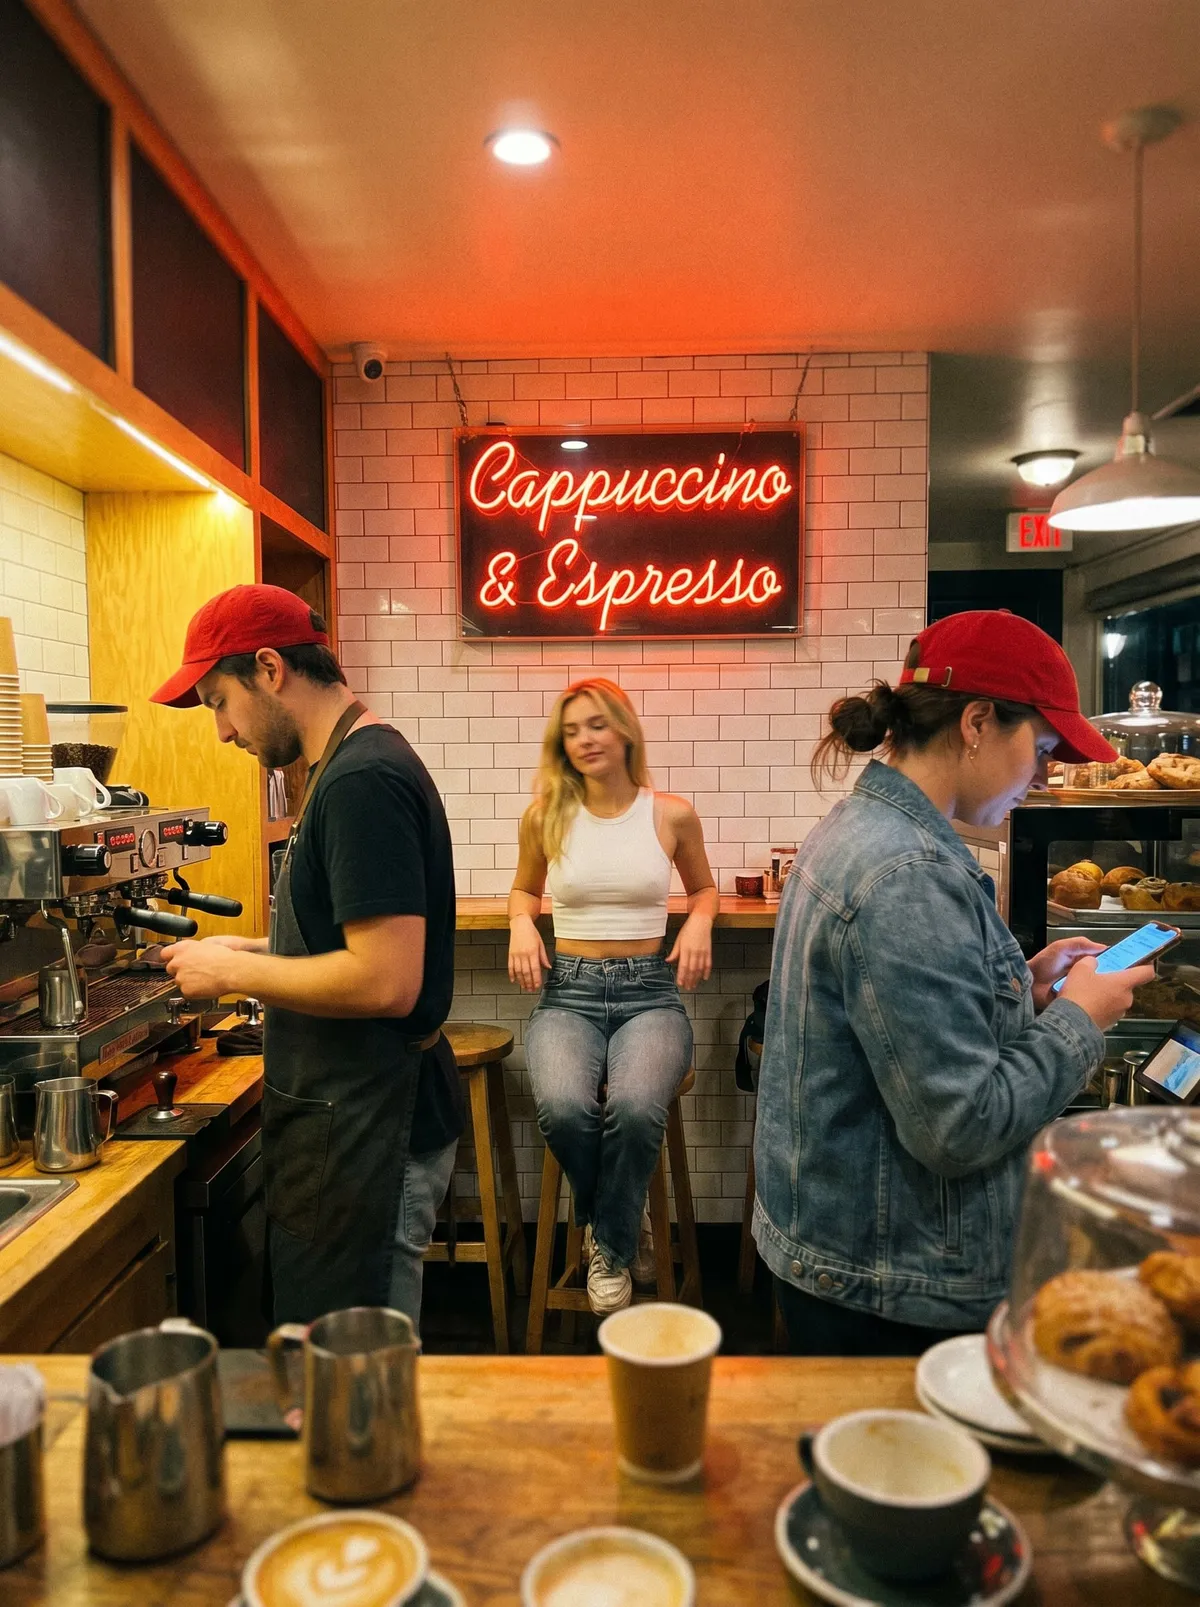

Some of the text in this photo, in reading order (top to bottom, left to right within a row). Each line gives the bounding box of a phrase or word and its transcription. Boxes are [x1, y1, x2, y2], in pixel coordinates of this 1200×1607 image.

[469, 441, 792, 532] Cappuccino
[479, 538, 782, 631] & Espresso
